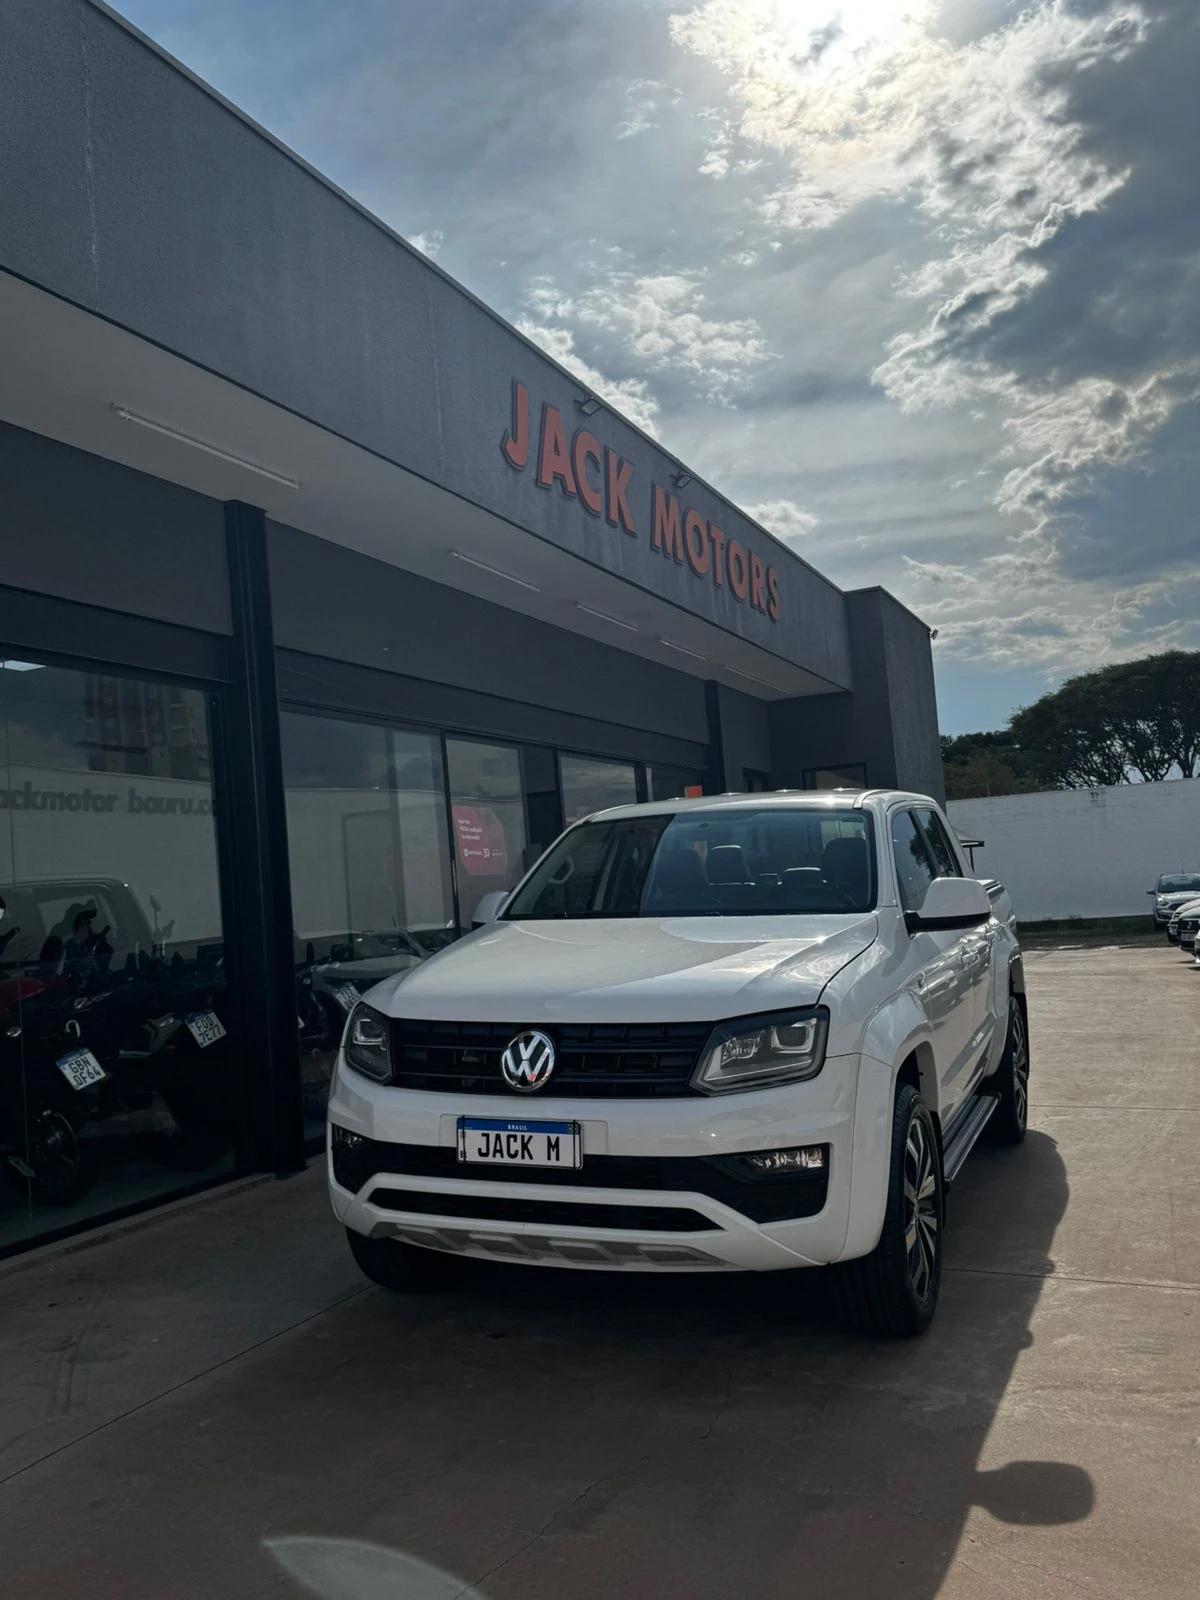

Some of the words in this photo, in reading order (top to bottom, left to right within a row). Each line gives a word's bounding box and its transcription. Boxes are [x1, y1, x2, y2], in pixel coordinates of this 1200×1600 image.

[501, 378, 637, 536] JACK
[651, 481, 781, 621] MOTORS
[68, 1057, 91, 1074] GBN
[503, 1032, 553, 1088] VW
[478, 1132, 534, 1160] JACK
[547, 1135, 560, 1162] M
